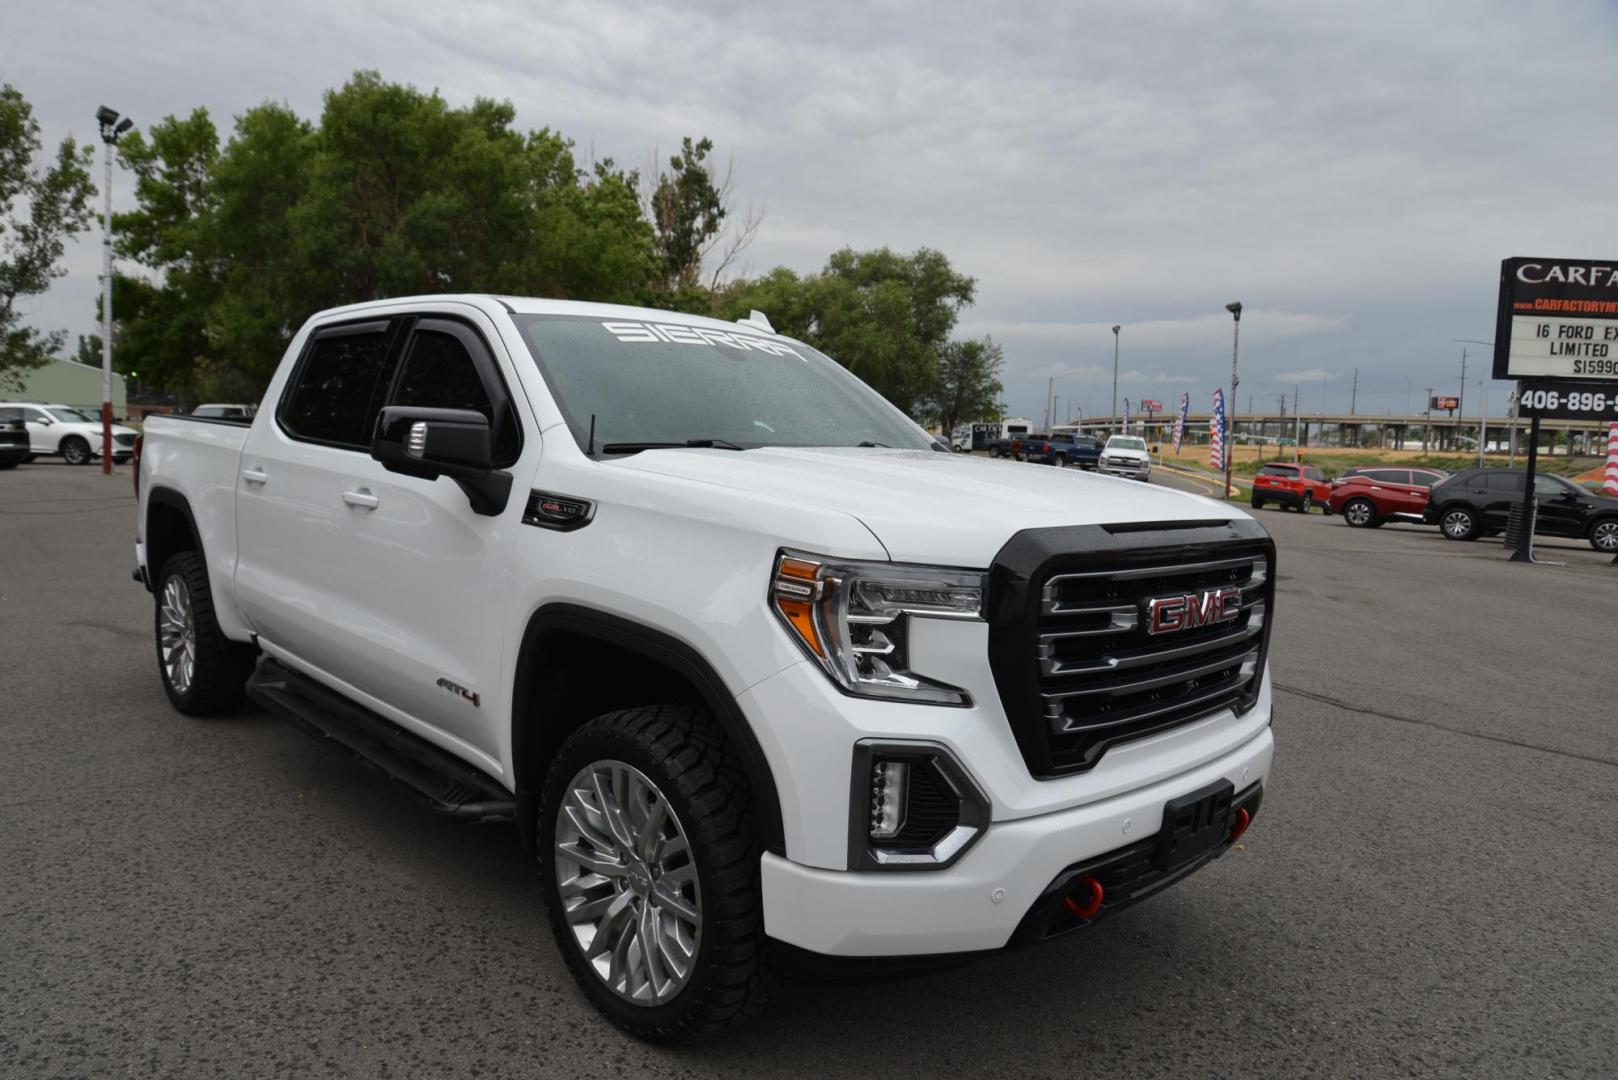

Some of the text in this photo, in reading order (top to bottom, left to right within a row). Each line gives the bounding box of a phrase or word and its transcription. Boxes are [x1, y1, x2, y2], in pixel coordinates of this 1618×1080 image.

[601, 322, 808, 363] SIERRA
[1537, 324, 1550, 338] 16
[1559, 325, 1594, 340] FORD
[1550, 342, 1608, 357] LIMITED
[1148, 588, 1241, 635] GMC
